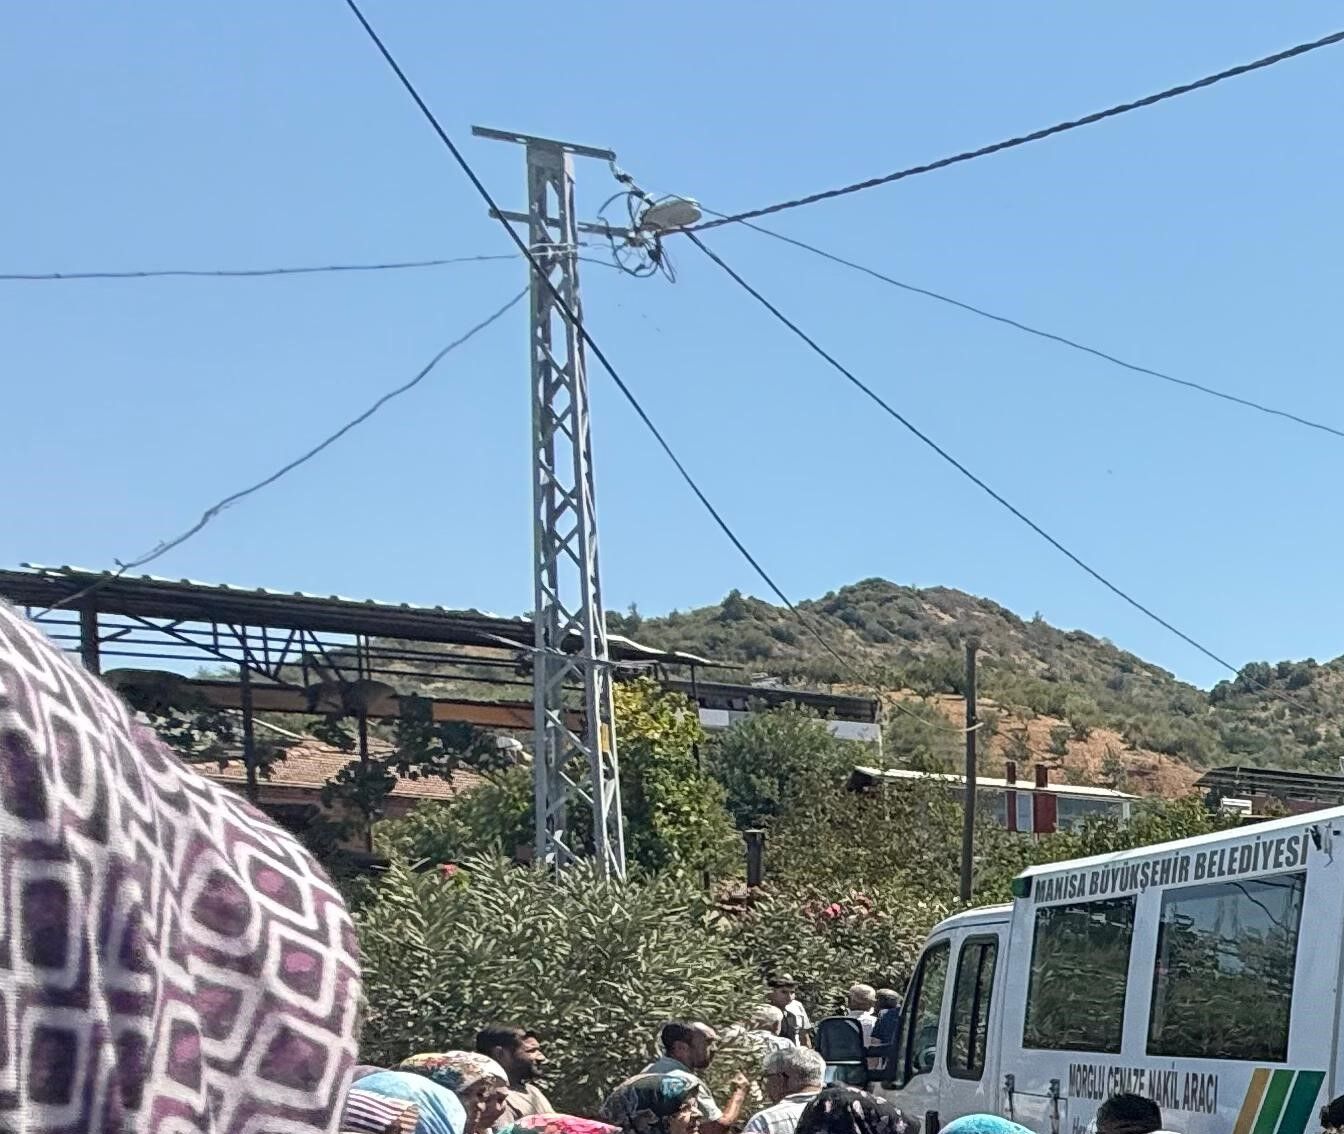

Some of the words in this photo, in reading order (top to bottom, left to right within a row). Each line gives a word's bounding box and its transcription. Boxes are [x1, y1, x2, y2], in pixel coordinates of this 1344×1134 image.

[1034, 871, 1086, 904] MANİSA
[1088, 850, 1189, 895] BÜYÜKŞEHİR
[1193, 828, 1310, 881] BELEDİYESİ
[1068, 1063, 1106, 1100] MORGLU
[1148, 1061, 1180, 1110] NAKİL
[1182, 1072, 1219, 1115] ARACI
